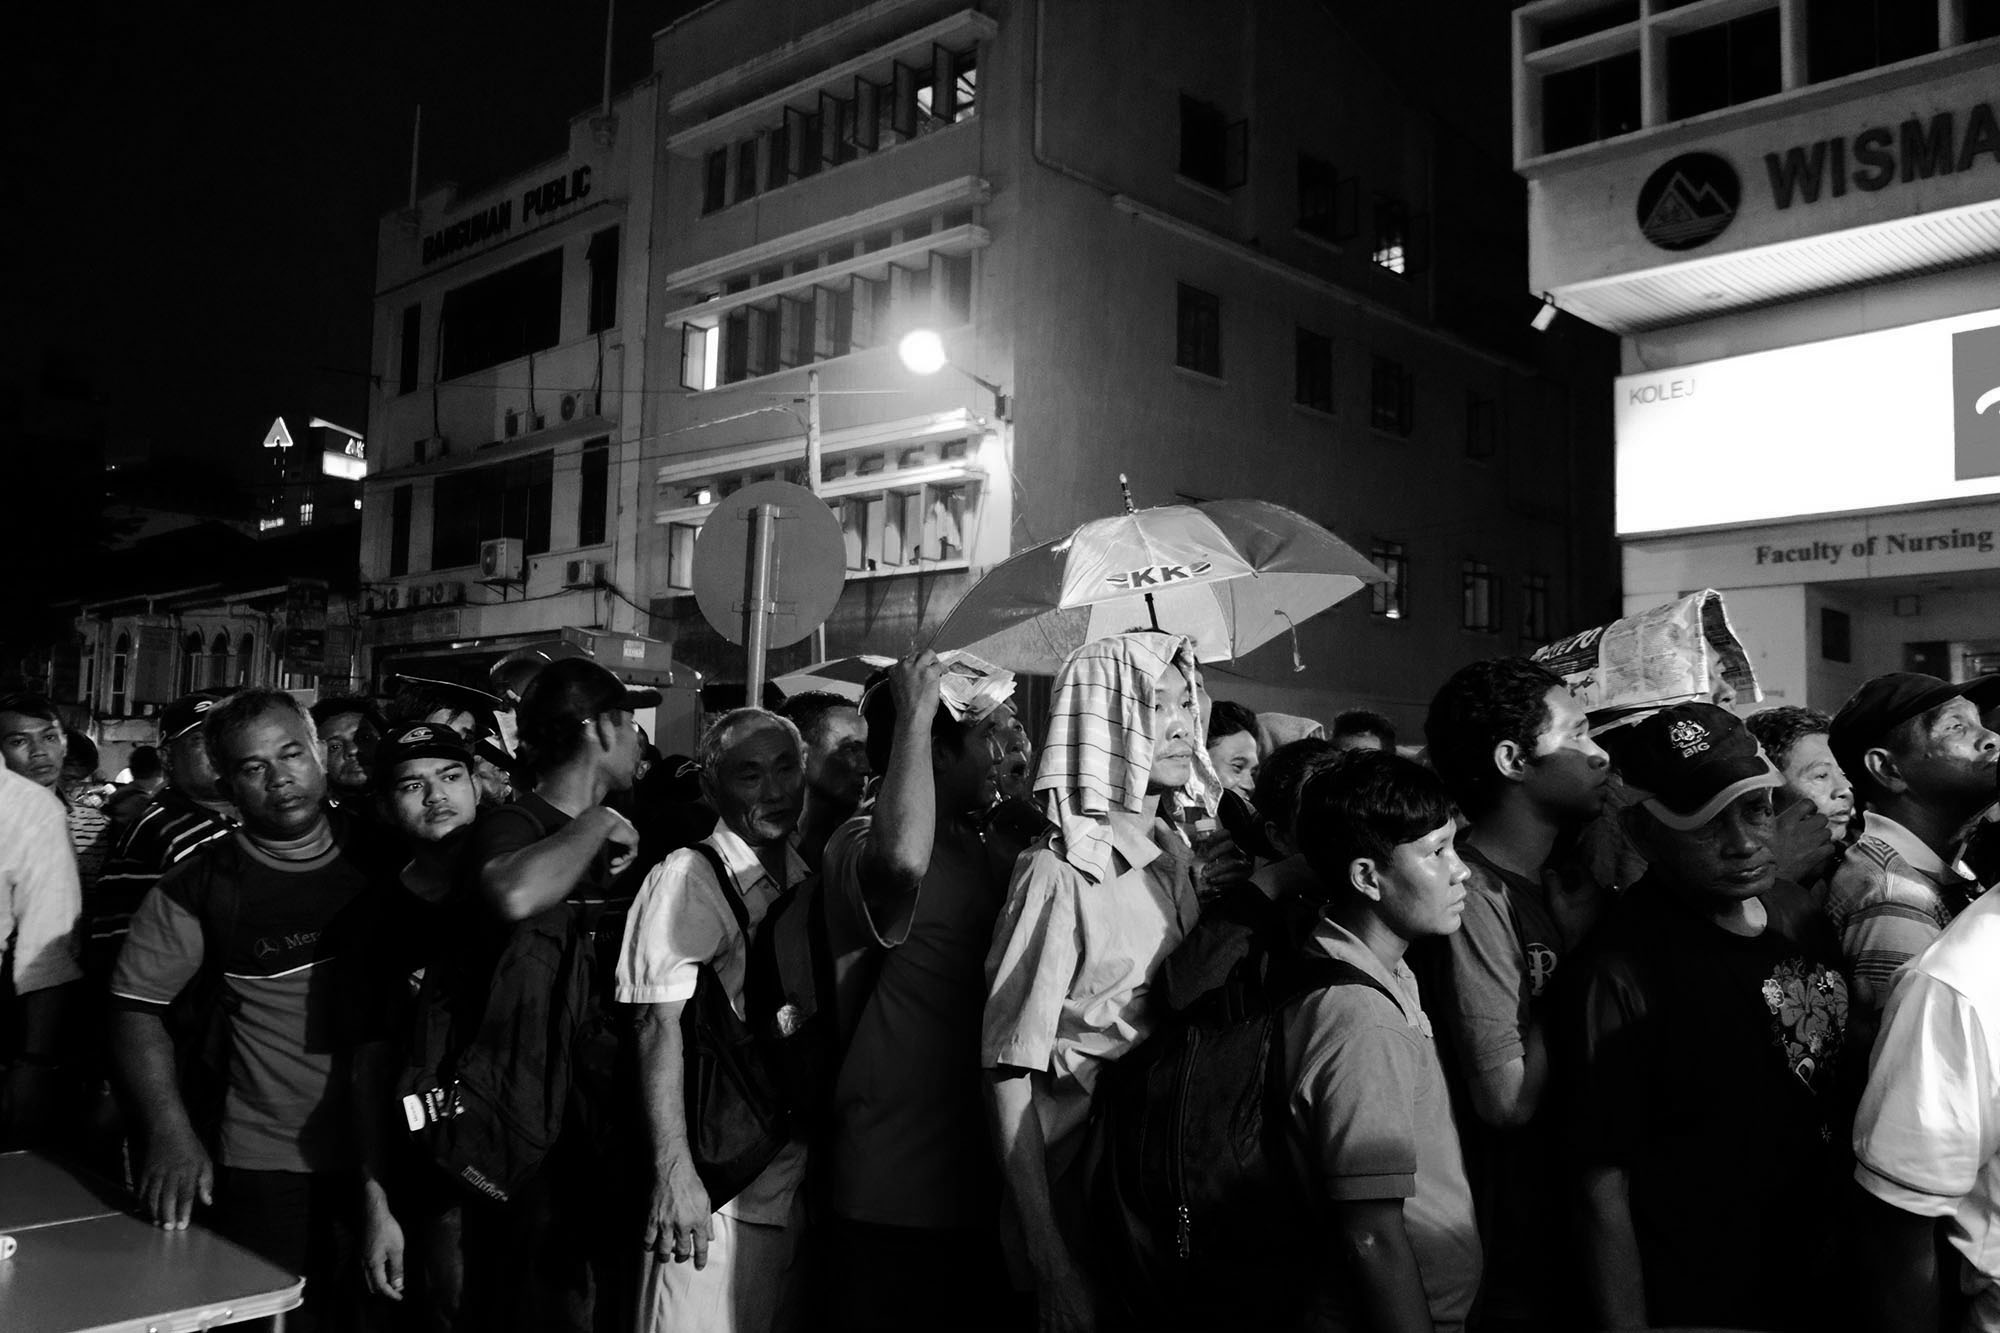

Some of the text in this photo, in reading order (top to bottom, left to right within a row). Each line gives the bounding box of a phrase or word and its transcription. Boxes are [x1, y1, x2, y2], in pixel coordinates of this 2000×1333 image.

[1763, 102, 2000, 211] WISMA
[522, 165, 592, 223] PUBLIC
[1629, 379, 1696, 406] KOLEJ
[1755, 527, 1995, 565] Faculty of Nursing
[1131, 566, 1189, 588] KK
[1682, 742, 1710, 758] BIG
